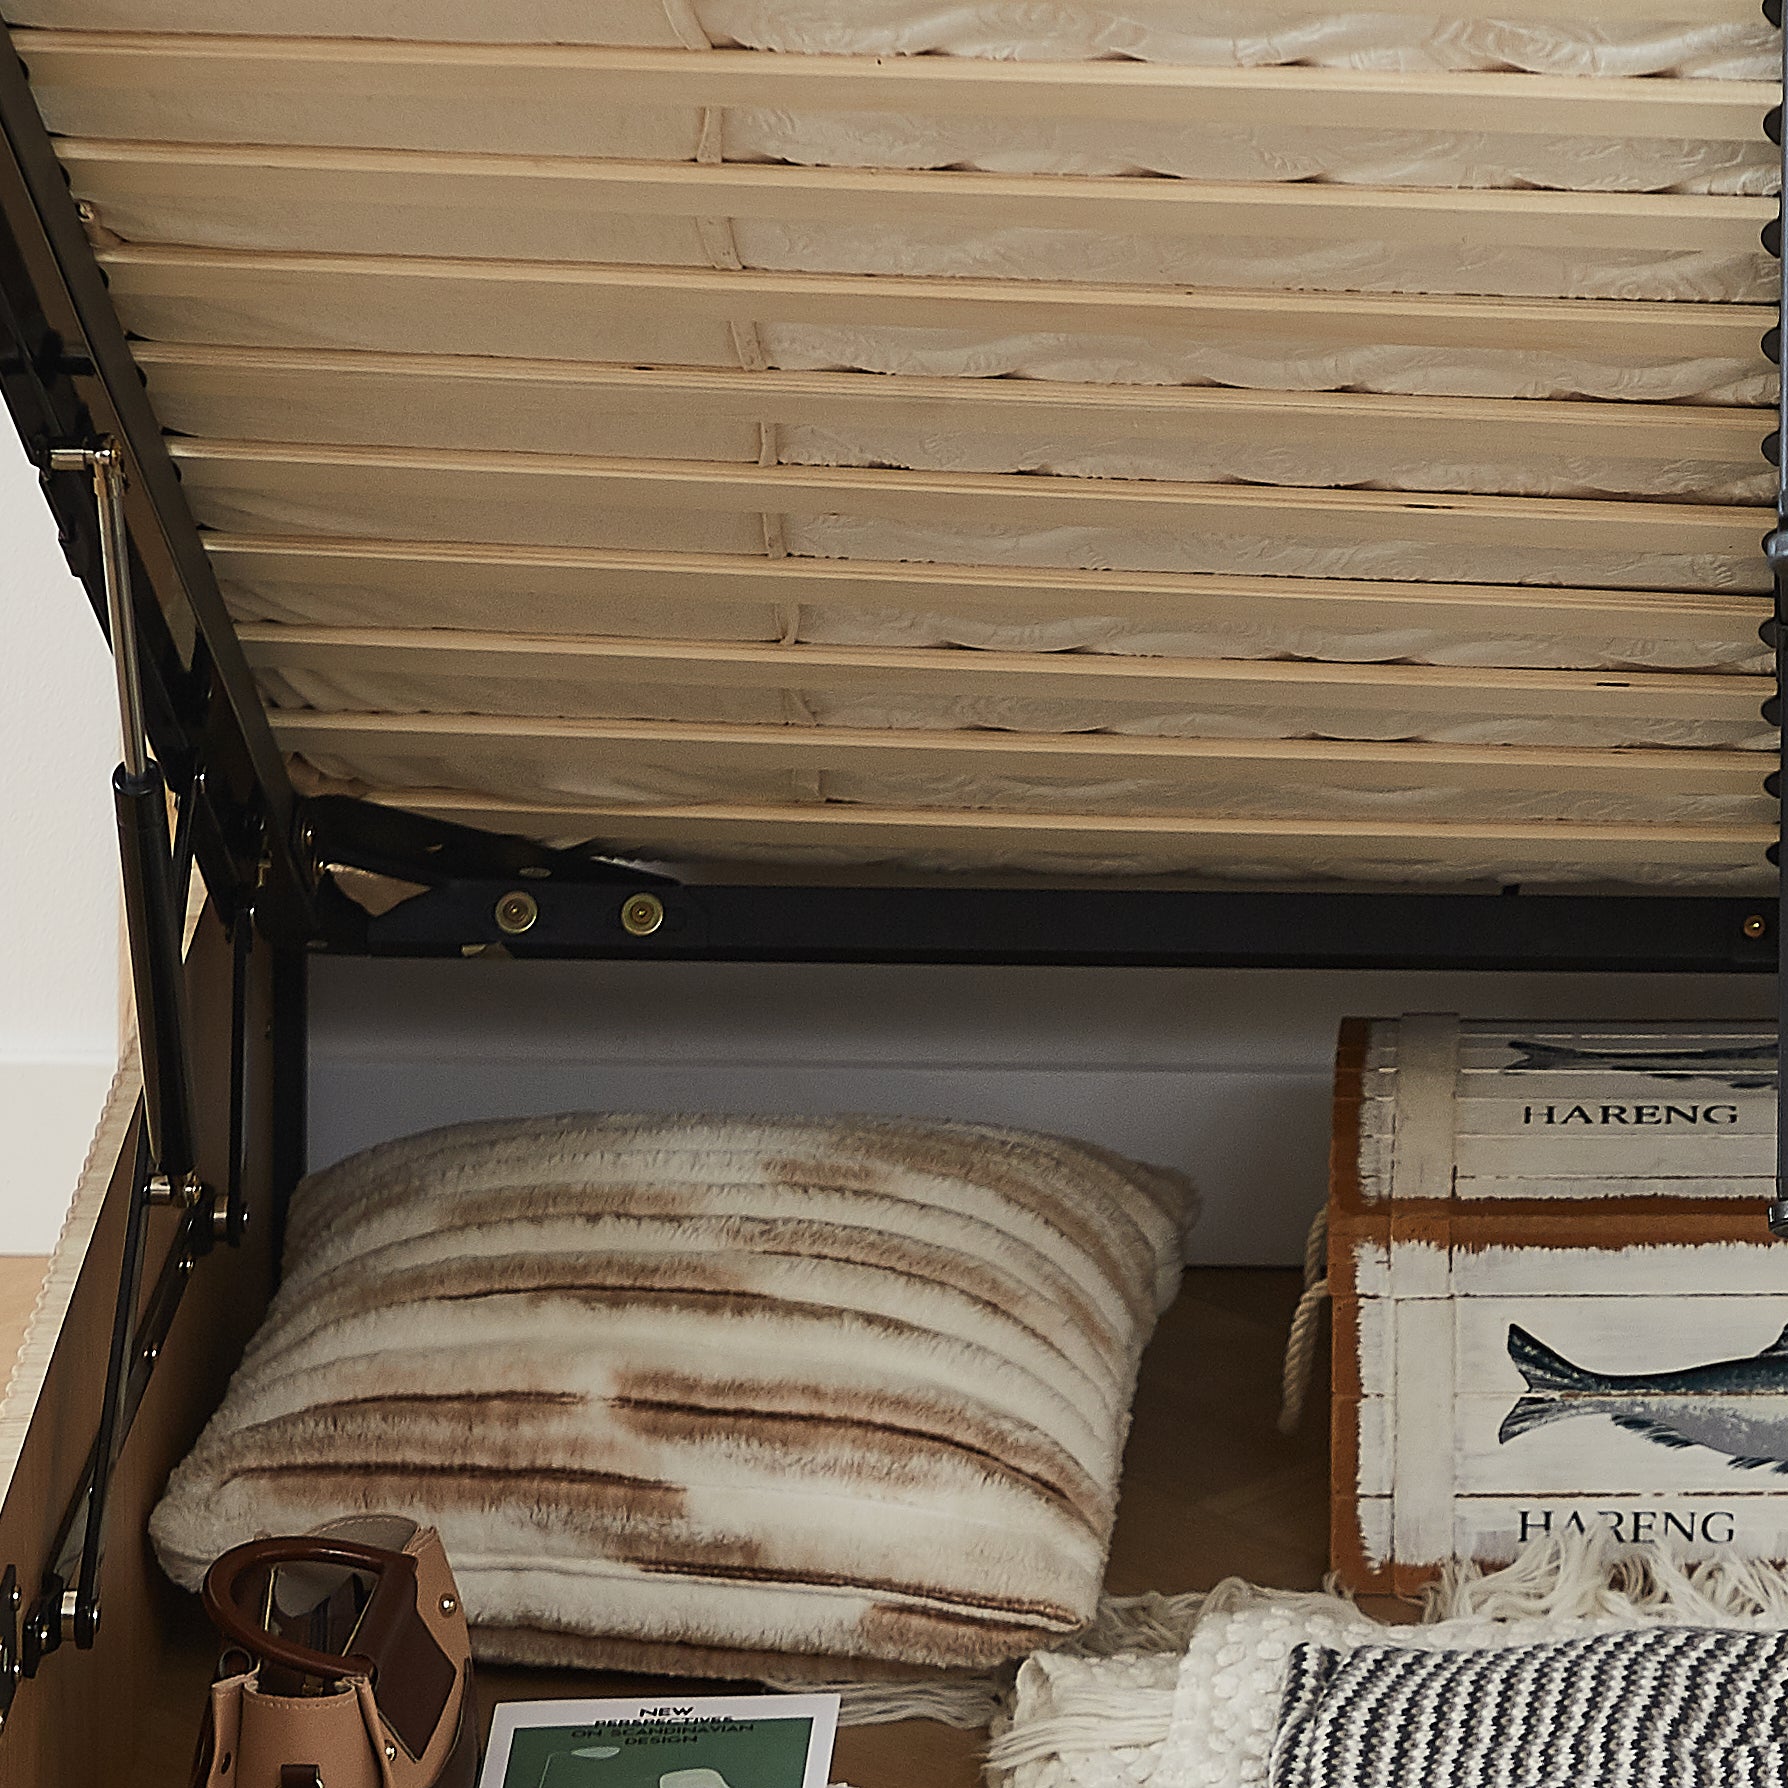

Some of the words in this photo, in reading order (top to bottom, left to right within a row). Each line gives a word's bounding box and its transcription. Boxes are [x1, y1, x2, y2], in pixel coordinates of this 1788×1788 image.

[1522, 1104, 1738, 1125] HARENG
[1517, 1509, 1736, 1543] HARENG
[639, 1706, 695, 1718] NEW
[593, 1715, 734, 1728] PERSPECTIVES
[571, 1729, 604, 1738] ON
[610, 1723, 755, 1738] SCANDINAVIAN
[625, 1734, 699, 1746] DESIGN
